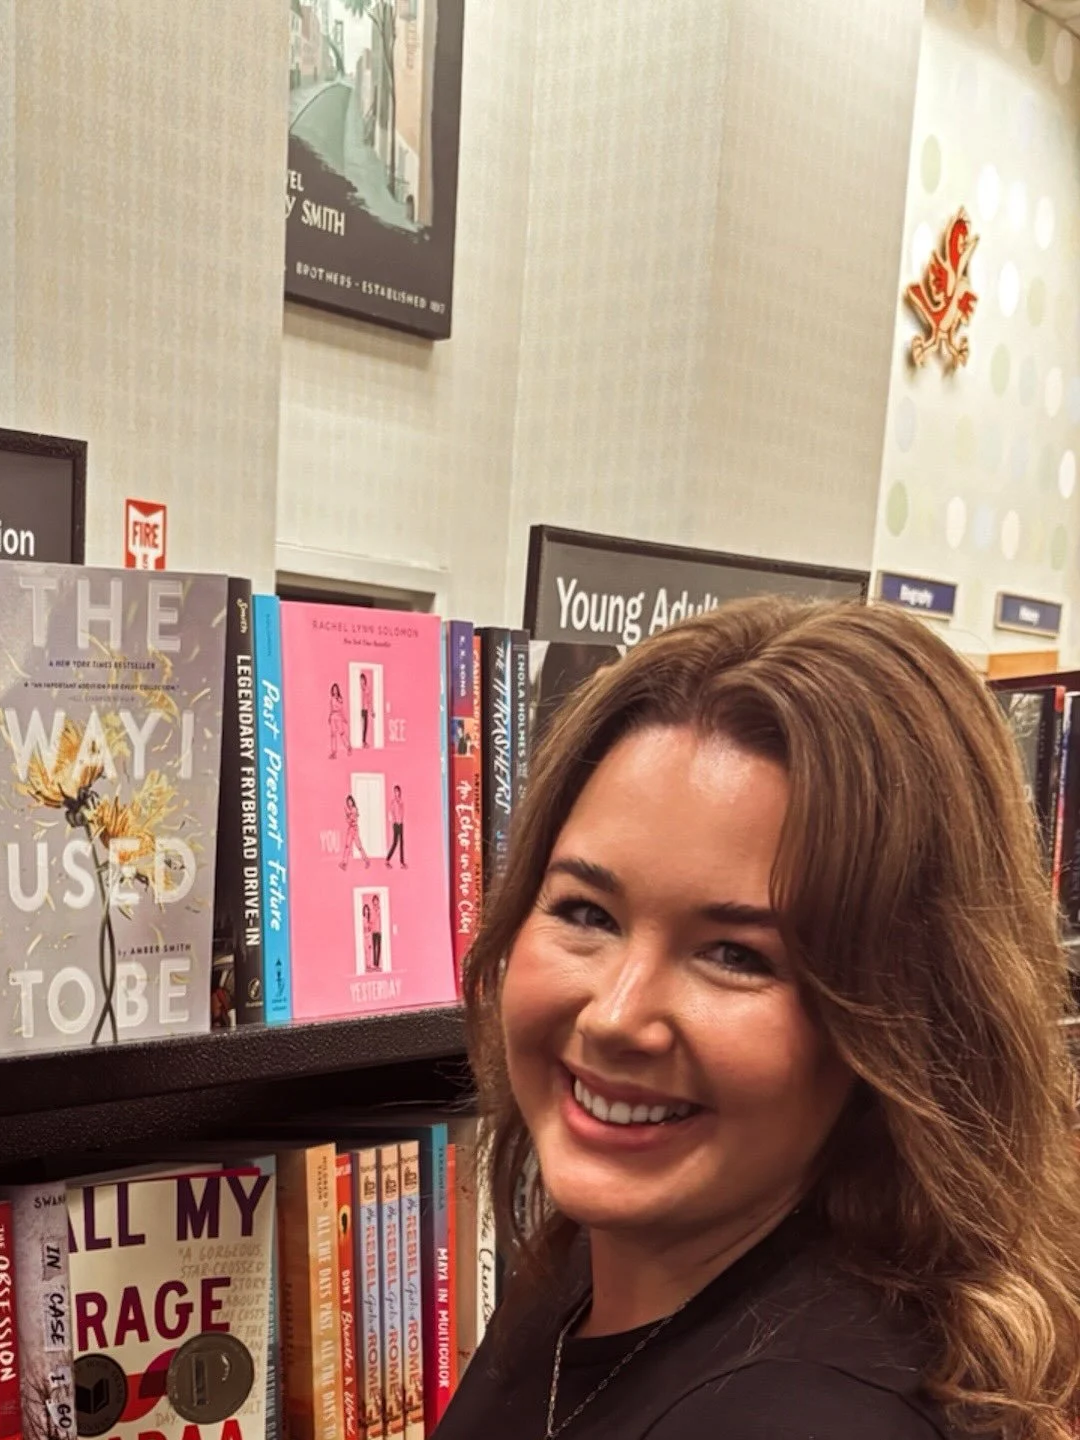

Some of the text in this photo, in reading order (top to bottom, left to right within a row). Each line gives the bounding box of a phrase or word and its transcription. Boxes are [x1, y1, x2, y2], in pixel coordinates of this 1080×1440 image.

[301, 199, 346, 236] SMITH
[296, 261, 427, 310] BROTHERS ESTABLISHED
[132, 521, 160, 549] FIRE
[312, 620, 419, 638] RACHEL LYNN SOLOMON
[557, 577, 645, 646] Young
[261, 679, 280, 741] Past
[236, 654, 261, 946] LEGENDARY FRYBREAD DRIVE-IN
[264, 747, 283, 847] Present
[267, 856, 282, 933] Future
[130, 942, 192, 957] AMBER SMITH
[349, 977, 402, 1001] YESTERDAY
[176, 1176, 270, 1242] MY
[76, 1277, 232, 1353] RAGE
[437, 1248, 450, 1390] MAYA IN MULTICOLOR
